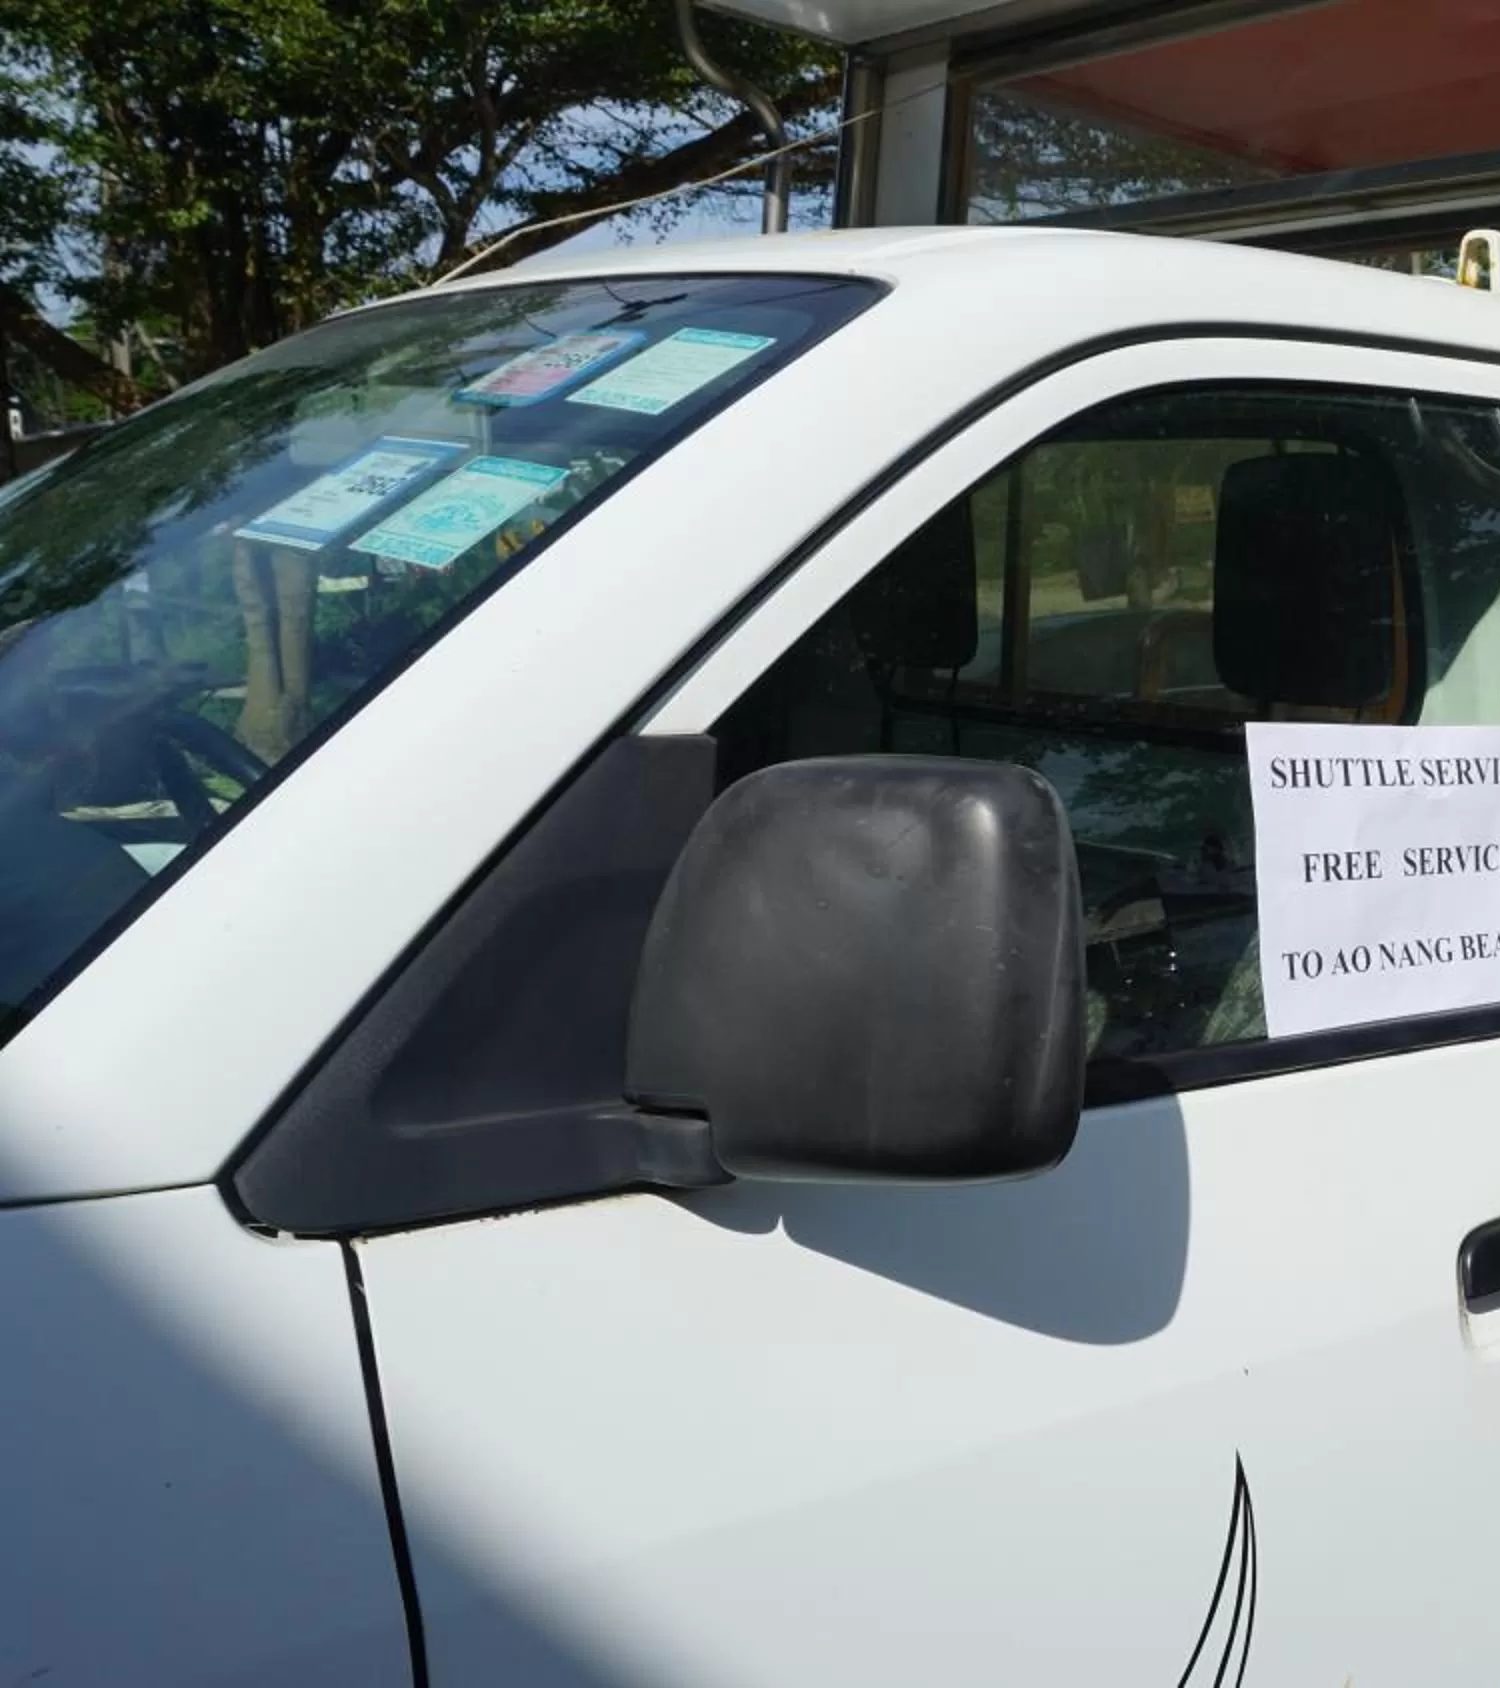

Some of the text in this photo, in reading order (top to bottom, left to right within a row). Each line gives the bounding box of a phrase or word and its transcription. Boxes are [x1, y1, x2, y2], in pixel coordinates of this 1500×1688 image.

[1270, 757, 1415, 788] SHUTTLE
[1302, 850, 1383, 883] FREE
[1281, 951, 1323, 981] TO
[1331, 945, 1372, 976] AO
[1379, 938, 1452, 966] NANG
